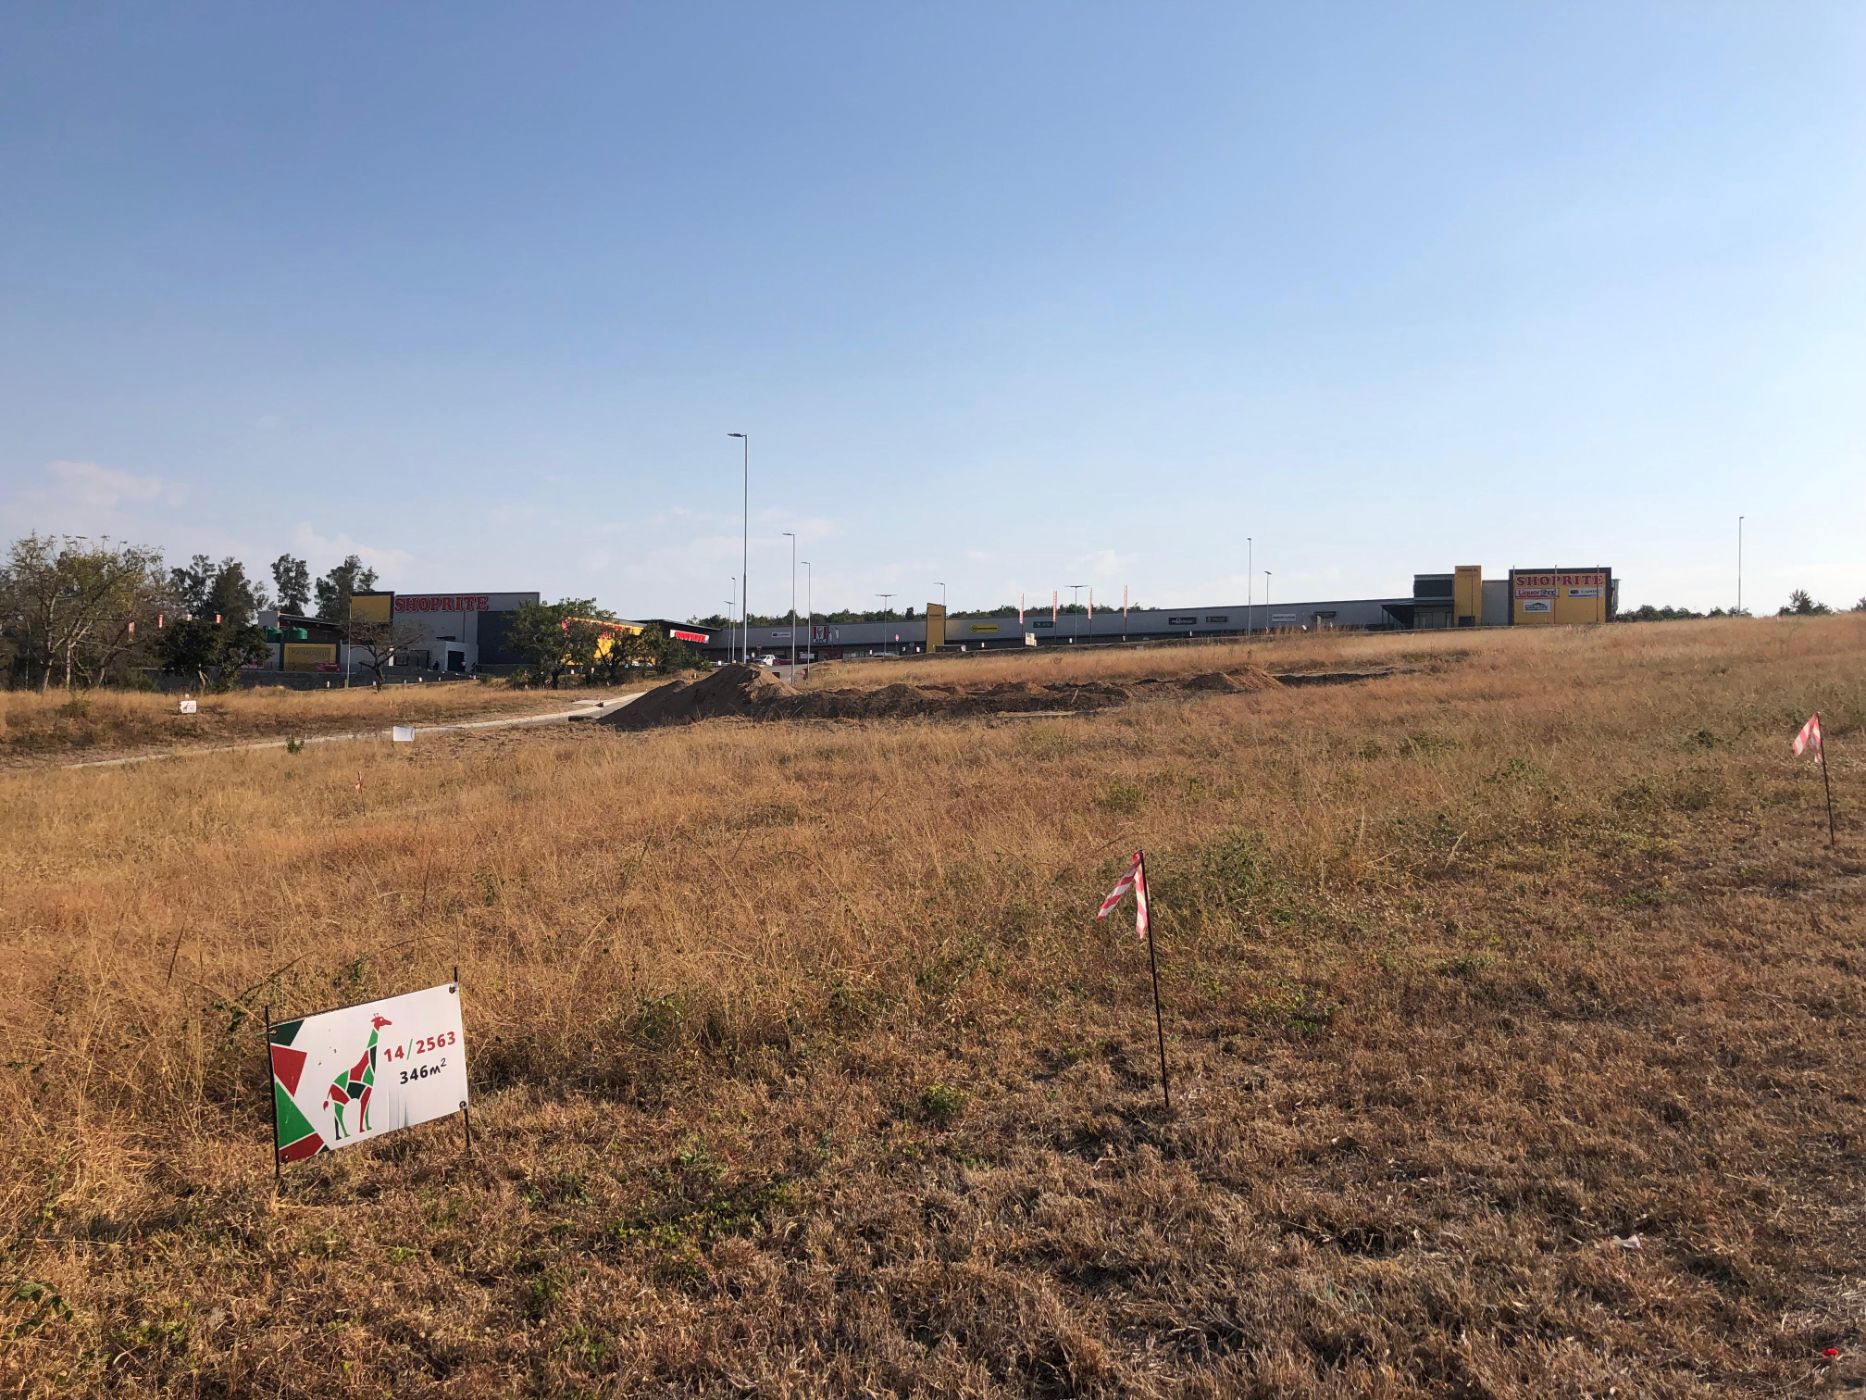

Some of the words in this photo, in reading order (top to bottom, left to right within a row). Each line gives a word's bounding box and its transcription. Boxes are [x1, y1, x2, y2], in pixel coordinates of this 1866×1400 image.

[1516, 575, 1603, 586] SHOPRITE
[394, 596, 488, 612] SHOPRITE
[384, 1031, 456, 1062] 14/2563
